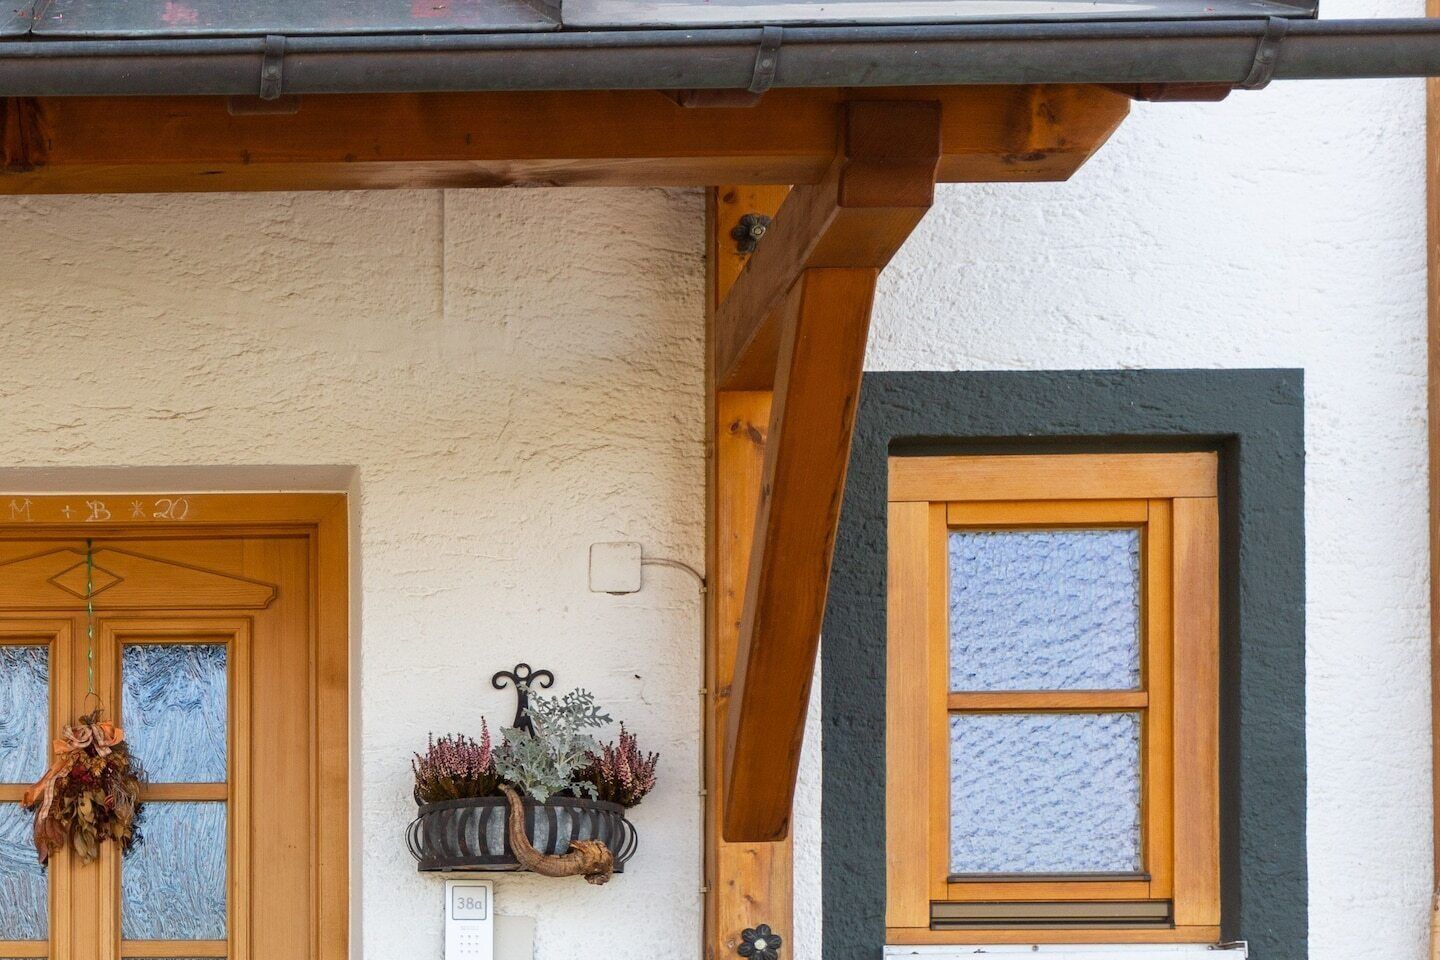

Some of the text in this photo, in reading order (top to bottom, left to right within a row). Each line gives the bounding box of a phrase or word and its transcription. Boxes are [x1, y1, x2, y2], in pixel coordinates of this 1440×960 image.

[9, 498, 33, 522] M
[152, 497, 191, 520] 20
[456, 896, 482, 910] 38a
